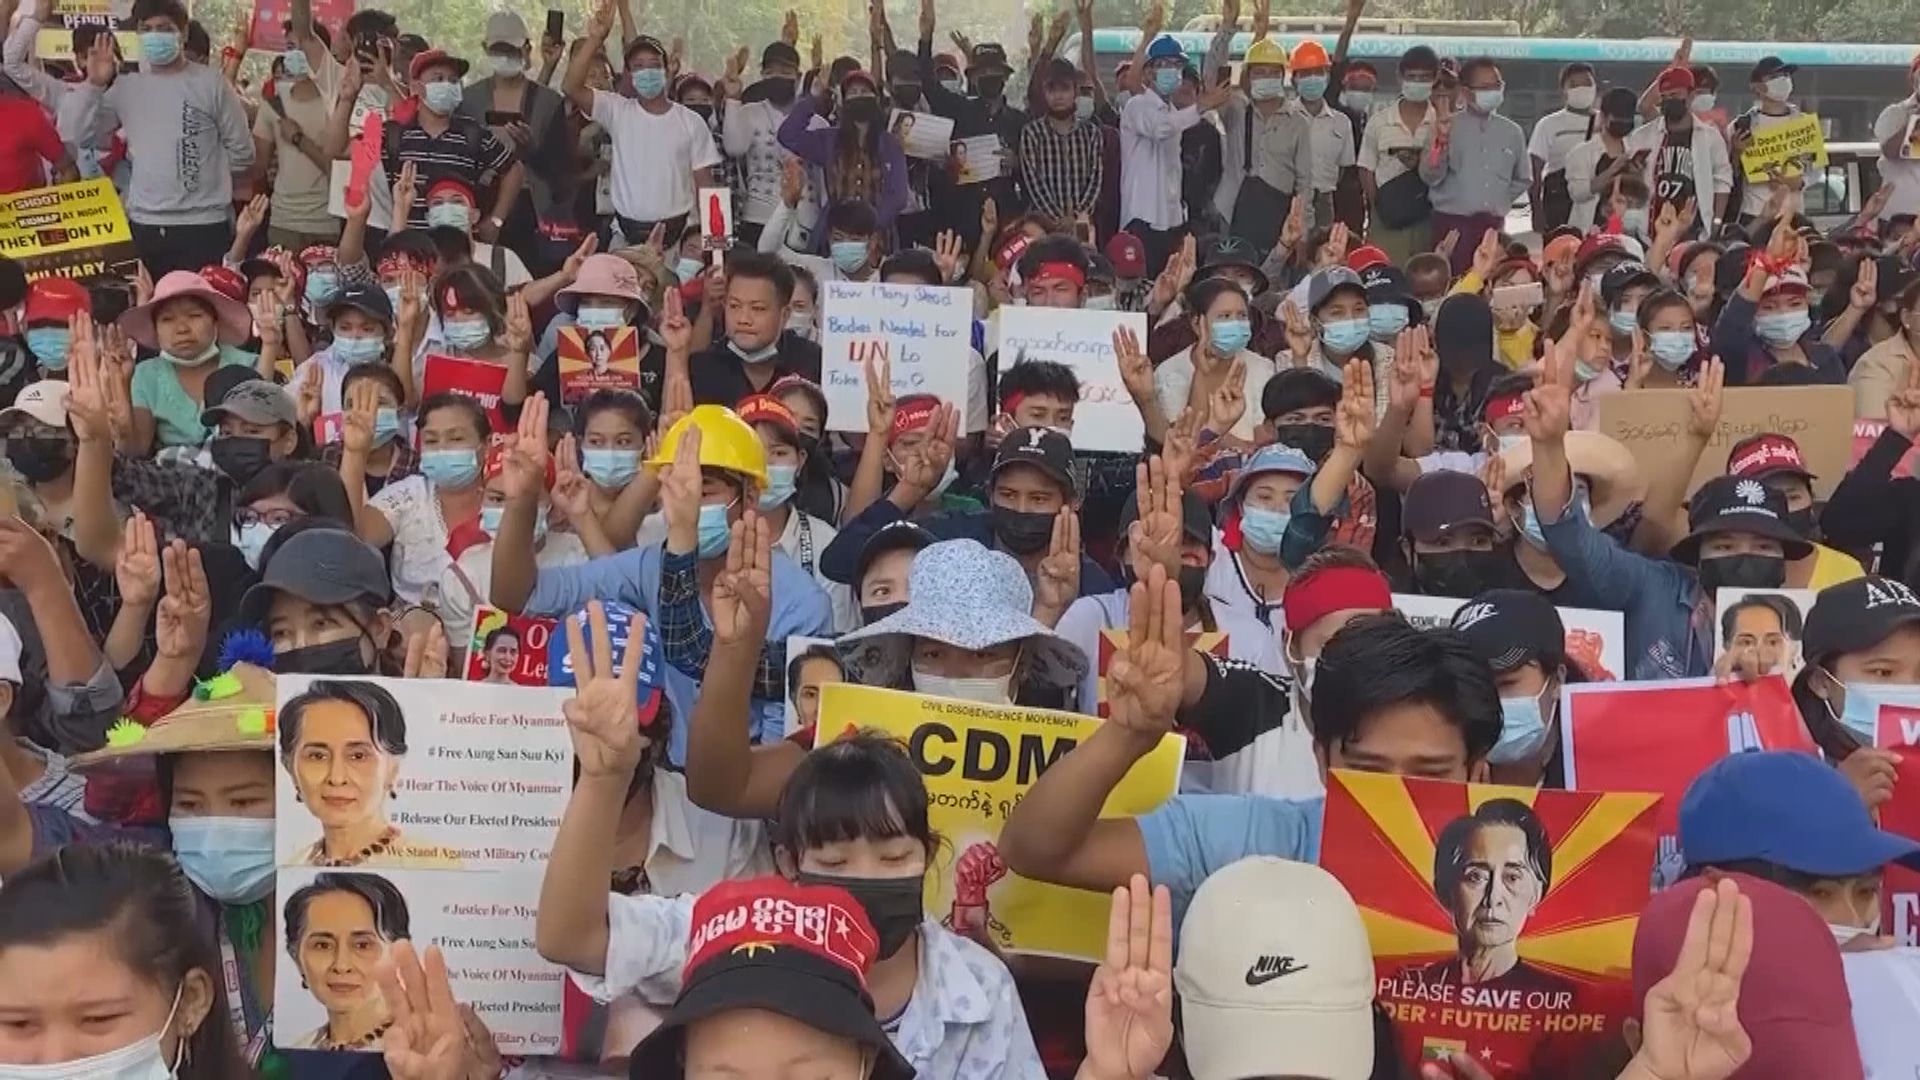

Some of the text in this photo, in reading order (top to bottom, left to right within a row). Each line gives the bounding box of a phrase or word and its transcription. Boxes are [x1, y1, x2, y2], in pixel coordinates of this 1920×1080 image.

[1658, 180, 1683, 198] 07
[16, 194, 60, 210] SHOOT
[61, 193, 74, 202] IN
[76, 188, 100, 200] DAY
[19, 214, 60, 228] KIDNAP
[62, 212, 75, 220] AT
[77, 207, 108, 218] NIGHT
[69, 227, 90, 240] ON
[93, 223, 114, 235] TV
[829, 286, 862, 300] How
[872, 287, 909, 307] Many
[848, 341, 888, 361] UN
[449, 712, 486, 726] Justice
[489, 714, 508, 726] For
[511, 714, 566, 729] Myanmar
[921, 701, 944, 713] CIVIL
[1026, 714, 1079, 728] MOVEMENT
[438, 746, 461, 758] Free
[465, 747, 495, 761] Aung
[497, 748, 518, 760] San
[520, 748, 542, 761] Suu
[544, 749, 565, 763] Kyi
[909, 722, 1077, 785] CDM
[406, 780, 433, 791] Hear
[437, 780, 457, 791] The
[460, 781, 488, 792] Voice
[491, 781, 507, 793] Of
[509, 782, 562, 796] Myanmar
[400, 812, 442, 824] Release
[444, 813, 466, 825] Our
[469, 814, 508, 827] Elected
[511, 814, 561, 828] President
[386, 845, 403, 857] We
[405, 846, 438, 858] Stand
[441, 847, 481, 860] Against
[484, 848, 526, 863] Military
[451, 904, 489, 916] Justice
[491, 905, 510, 917] For
[441, 936, 465, 948] Free
[468, 937, 497, 950] Aung
[499, 938, 519, 950] San
[1255, 955, 1295, 973] NIKE
[463, 970, 491, 980] Voice
[493, 970, 509, 981] Of
[511, 971, 562, 985] Myanmar
[1377, 977, 1572, 1010] PLEASE SAVE OUR
[471, 1001, 560, 1014] Elected President
[1440, 1008, 1533, 1031] FUTURE
[1543, 1014, 1605, 1032] HOPE
[530, 1032, 559, 1047] Coup
